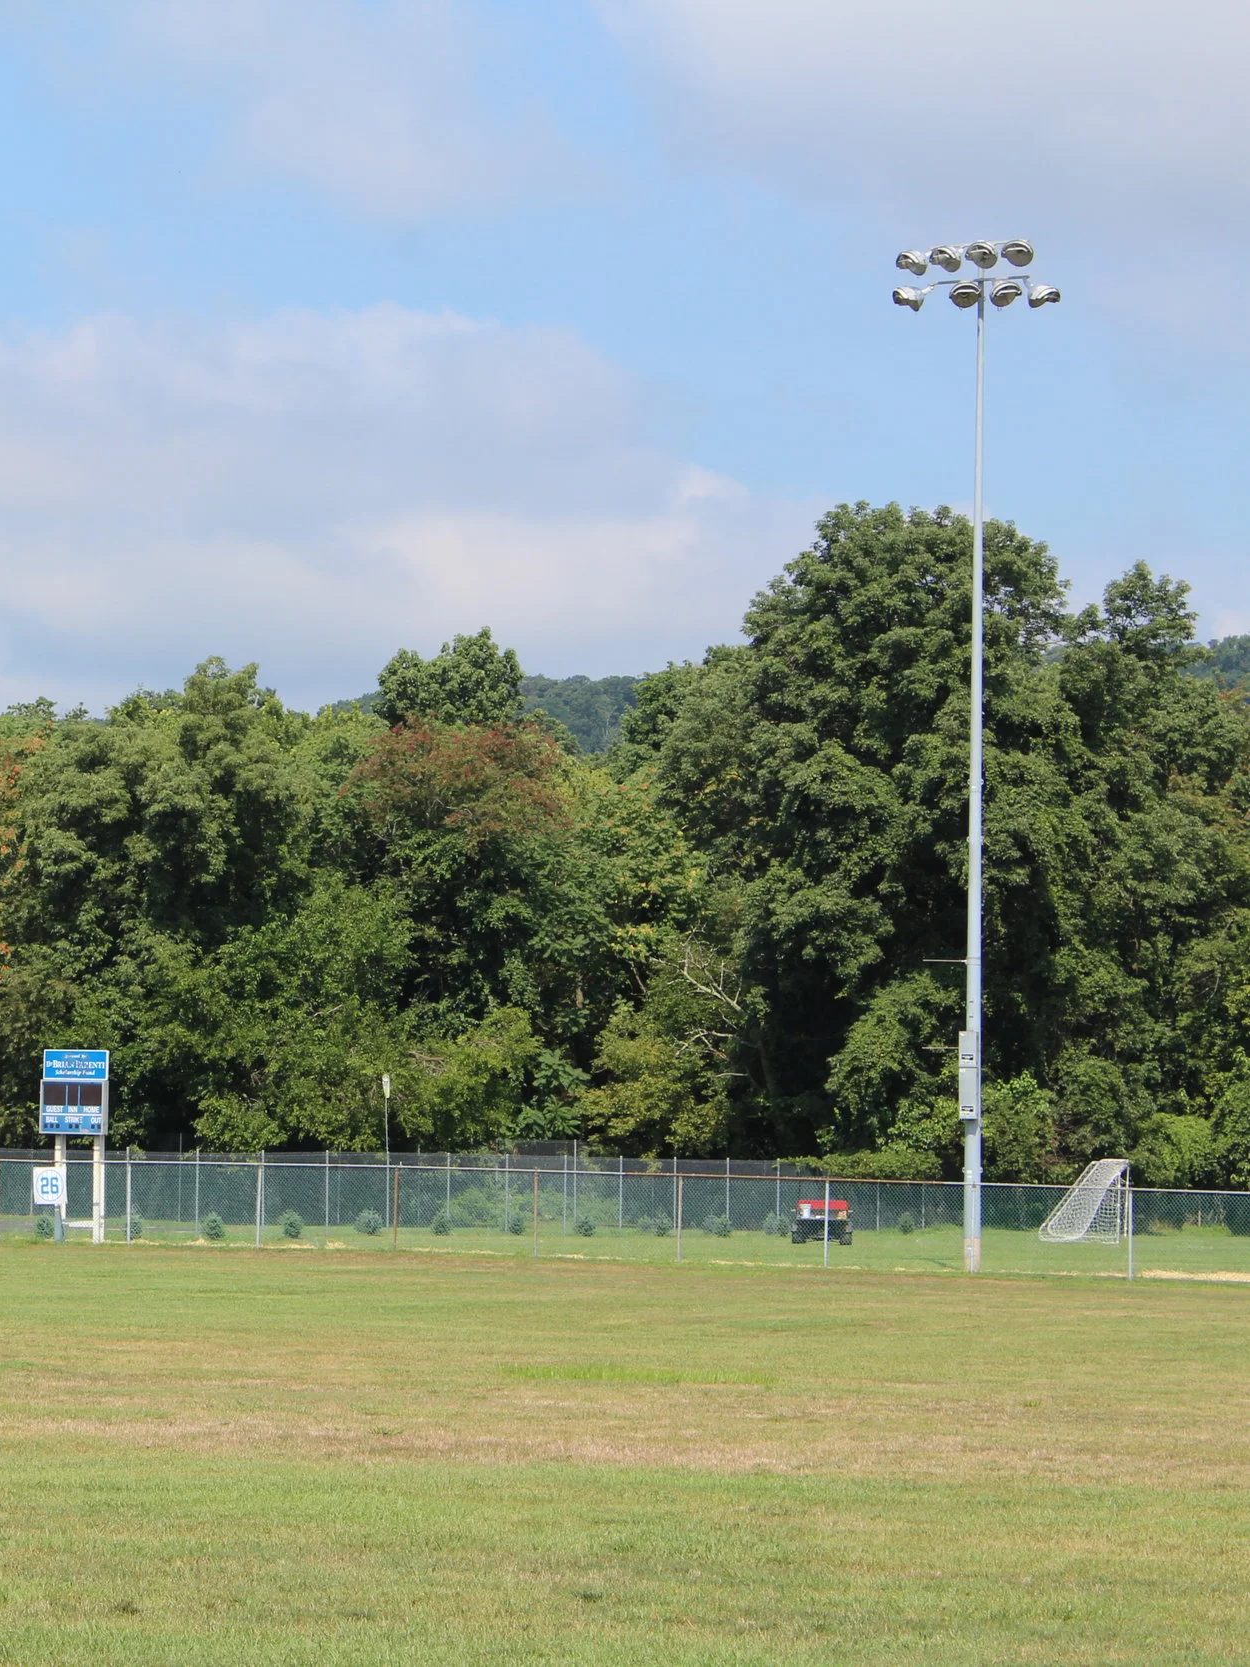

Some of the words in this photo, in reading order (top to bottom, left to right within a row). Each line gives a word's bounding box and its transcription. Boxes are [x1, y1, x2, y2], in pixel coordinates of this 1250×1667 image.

[45, 1105, 64, 1113] GUEST
[67, 1105, 78, 1113] INN
[83, 1105, 100, 1114] HOME
[45, 1116, 59, 1124] BALL
[64, 1116, 83, 1124] STRIKE
[90, 1116, 102, 1124] OUT
[40, 1176, 59, 1195] 26
